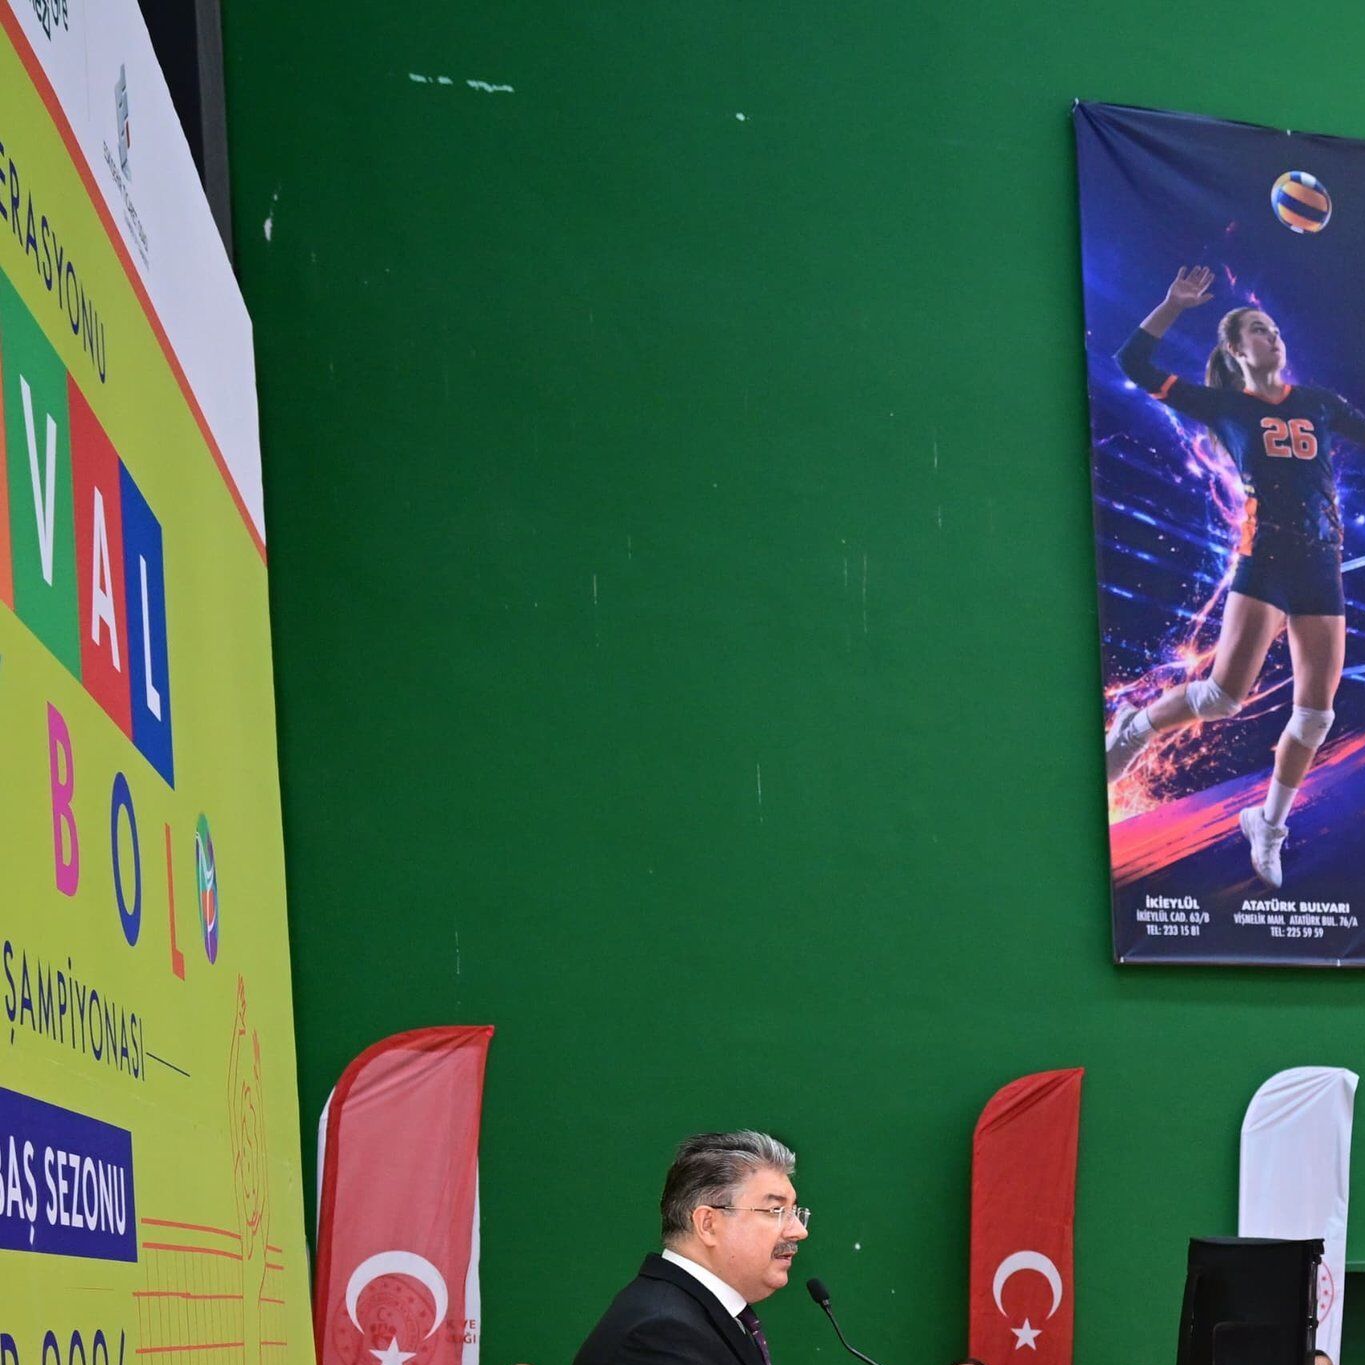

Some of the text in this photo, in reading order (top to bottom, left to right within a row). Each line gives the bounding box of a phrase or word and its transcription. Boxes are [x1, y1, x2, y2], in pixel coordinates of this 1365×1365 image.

[1261, 415, 1318, 461] 26
[1145, 894, 1200, 910] İKİEYLÜL
[1241, 898, 1350, 913] ATATÜRK BULVARI
[1171, 912, 1188, 923] CAD.
[1289, 914, 1320, 926] ATATÜRK
[1321, 916, 1337, 927] BUL.
[1147, 925, 1162, 936] TEL:
[1163, 925, 1179, 936] 233
[1180, 926, 1189, 936] 15
[1270, 927, 1323, 938] TEL: 225 59 59
[3, 940, 145, 1082] ŞAMPİYONASI
[44, 1146, 126, 1236] SEZONU
